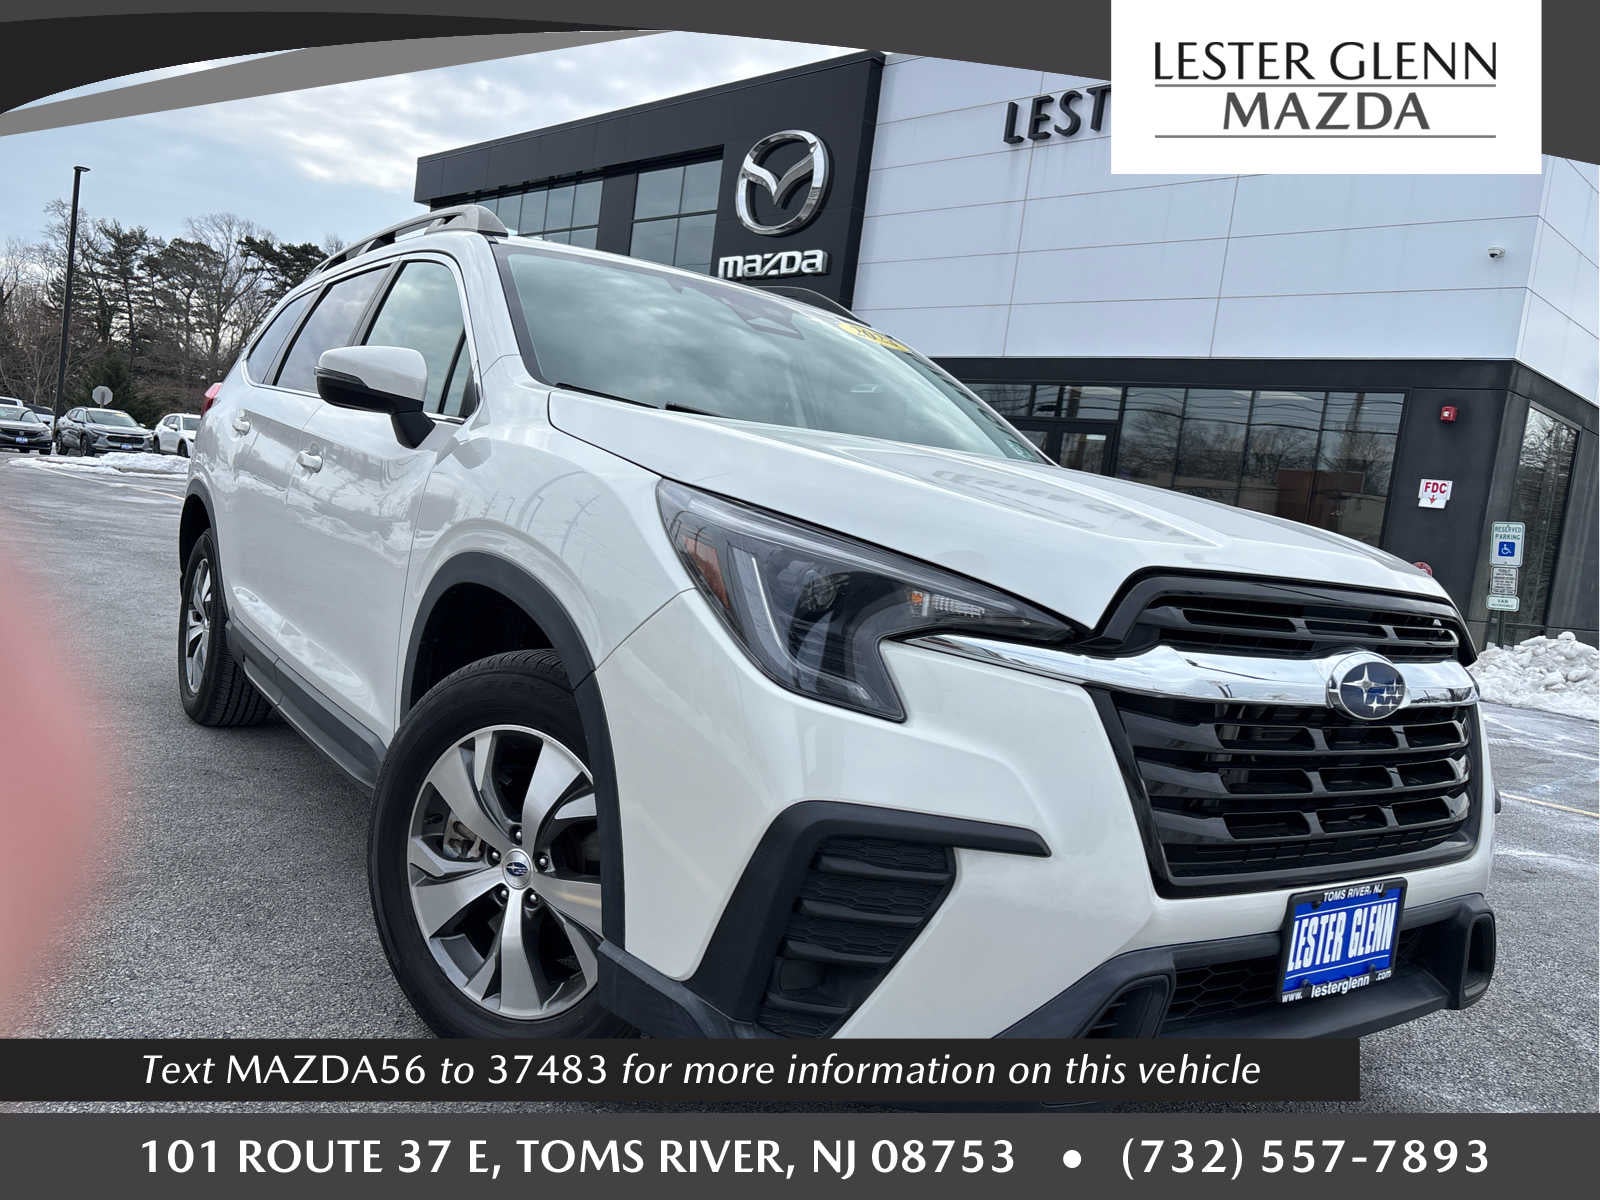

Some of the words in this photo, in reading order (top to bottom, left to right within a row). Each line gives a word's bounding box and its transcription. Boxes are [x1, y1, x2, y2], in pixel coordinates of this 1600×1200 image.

[1424, 482, 1448, 494] FDC
[1323, 889, 1346, 903] TOMS
[1373, 883, 1384, 894] NJ
[1287, 911, 1347, 972] LESTER
[1347, 902, 1397, 958] GLENN
[1282, 990, 1303, 1003] www.
[1311, 975, 1370, 998] lesterglenn
